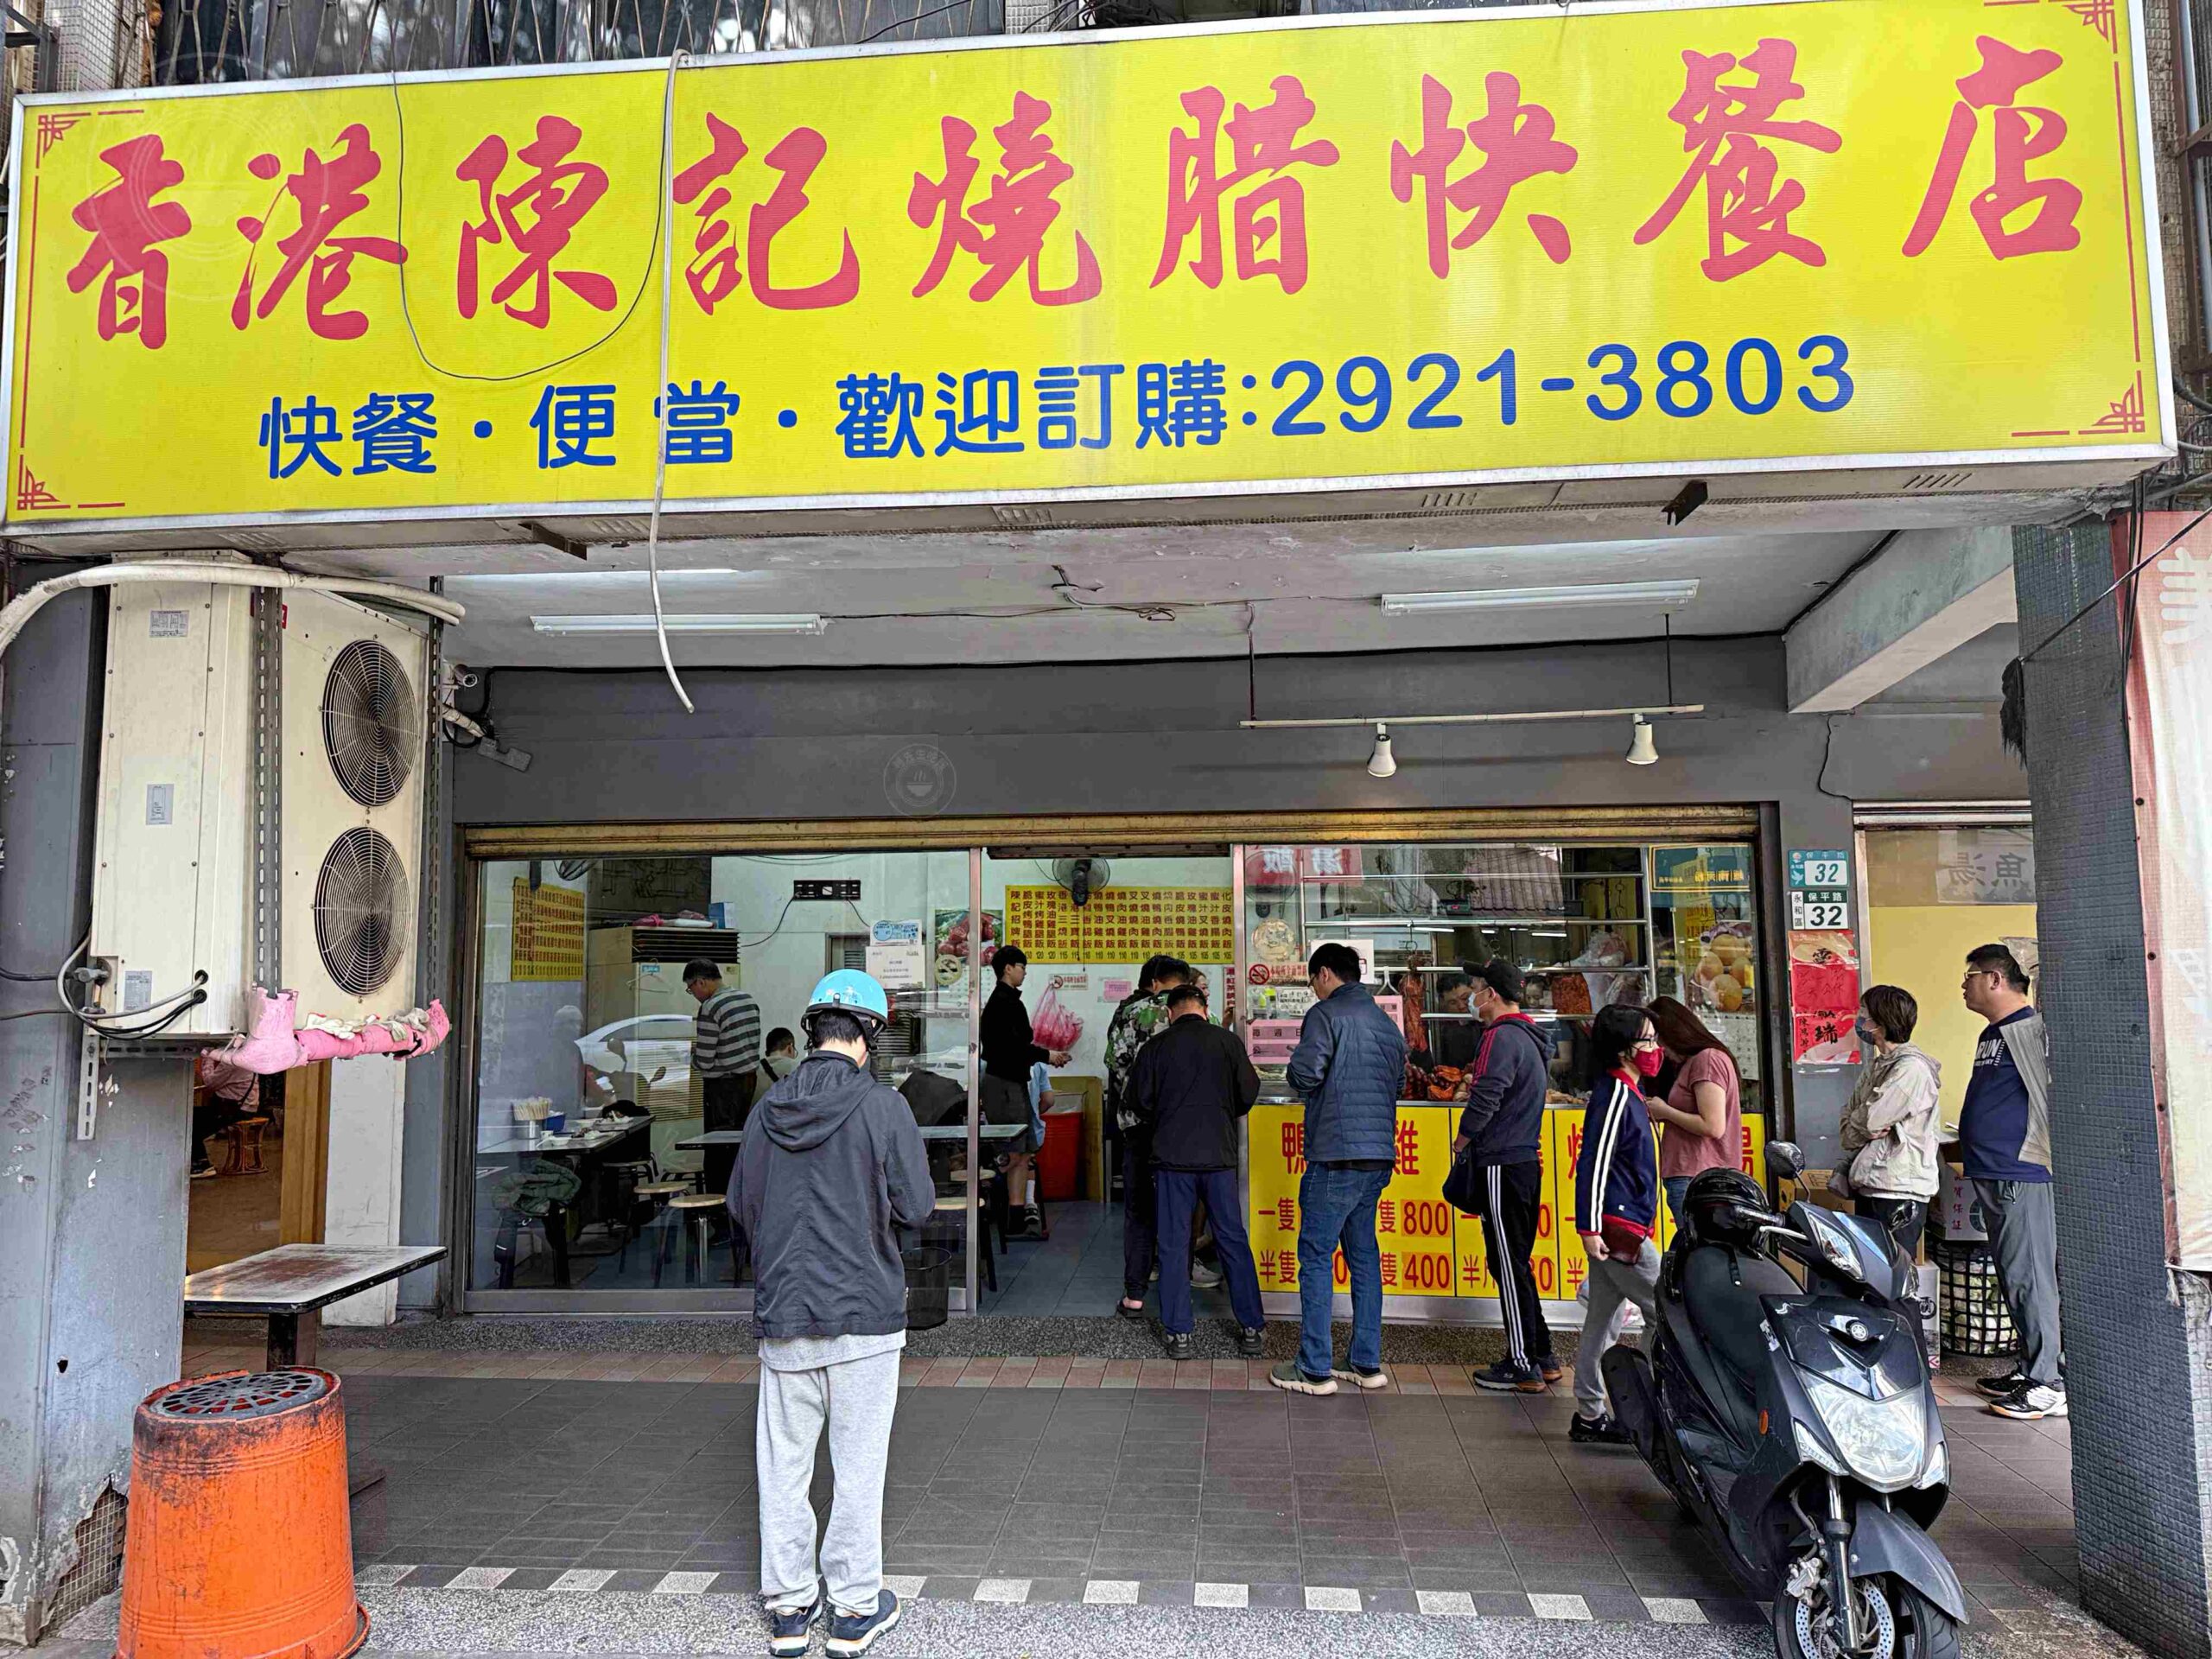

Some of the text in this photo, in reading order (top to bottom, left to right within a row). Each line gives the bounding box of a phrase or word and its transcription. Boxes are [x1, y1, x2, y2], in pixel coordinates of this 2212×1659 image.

[1815, 863, 1839, 883] 32
[1793, 893, 1802, 927] 永和區
[1808, 892, 1842, 902] 保平路
[1810, 906, 1842, 926] 32
[1403, 1202, 1449, 1236] 800
[1404, 1255, 1450, 1288] 400
